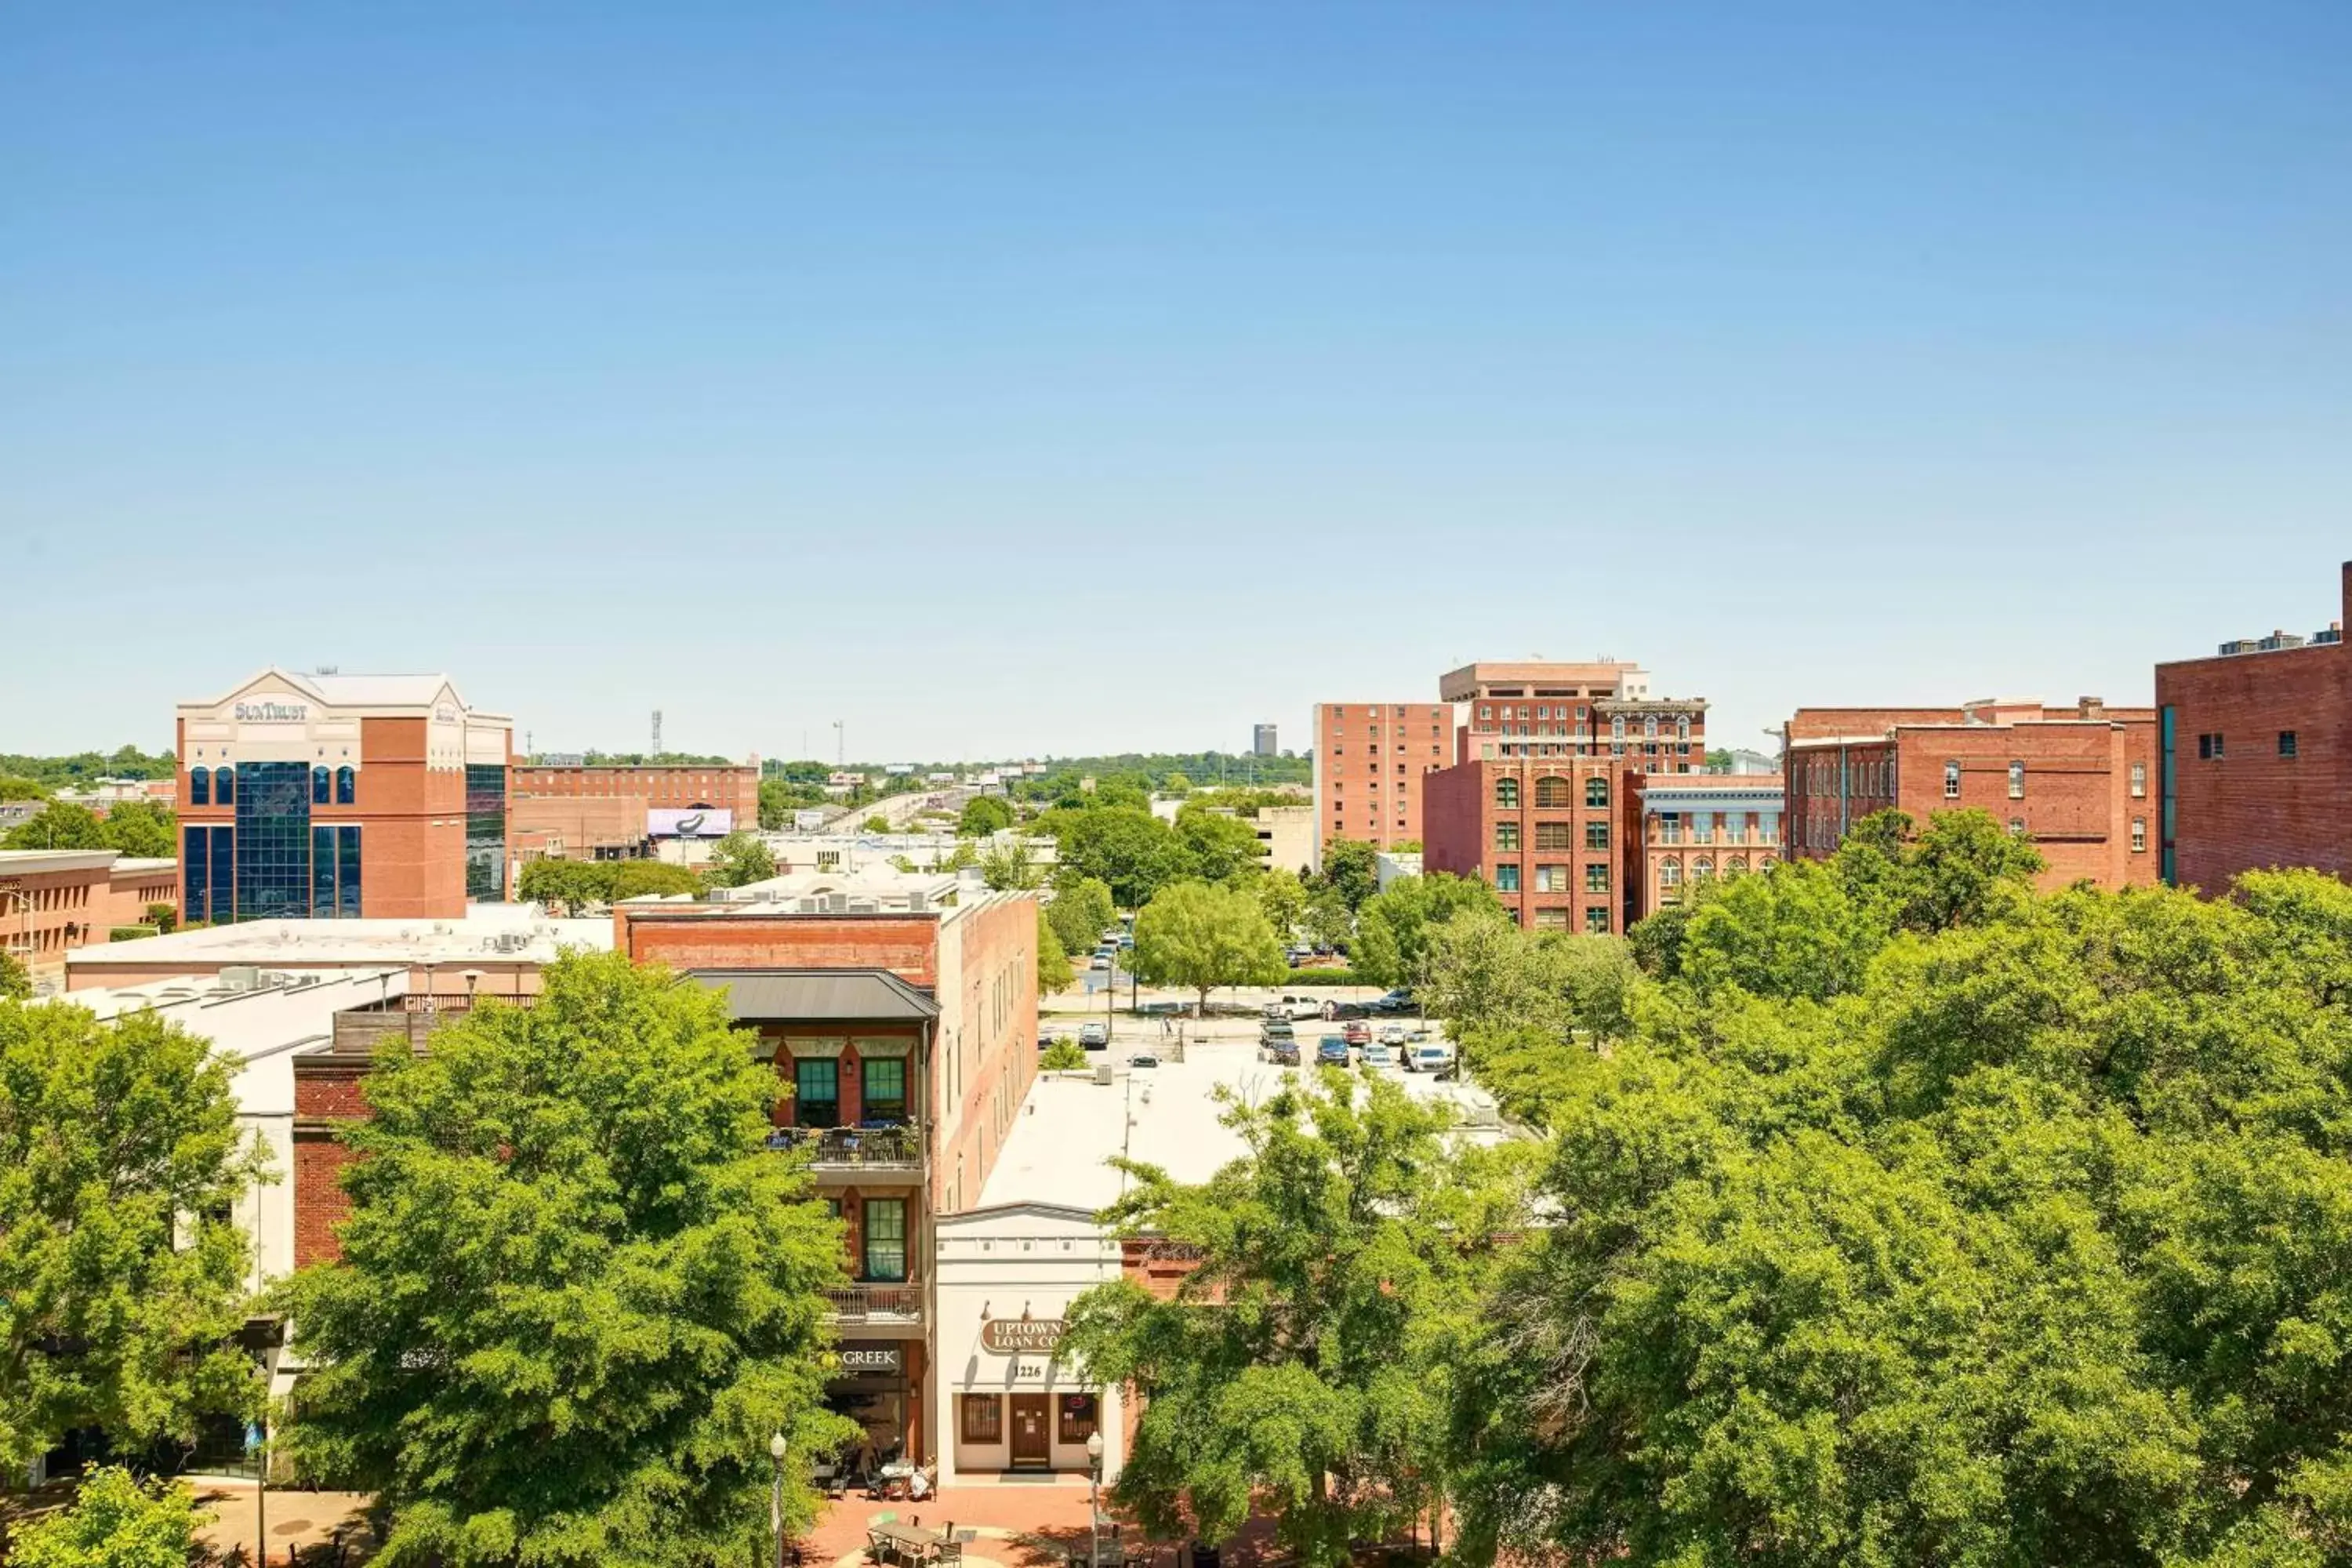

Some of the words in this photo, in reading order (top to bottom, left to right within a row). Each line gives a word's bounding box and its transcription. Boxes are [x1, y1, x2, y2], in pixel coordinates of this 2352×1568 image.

[993, 1323, 1062, 1334] UPTOWN
[995, 1335, 1033, 1347] LOAN
[843, 1351, 895, 1364] GREEK
[1014, 1366, 1041, 1377] 1226
